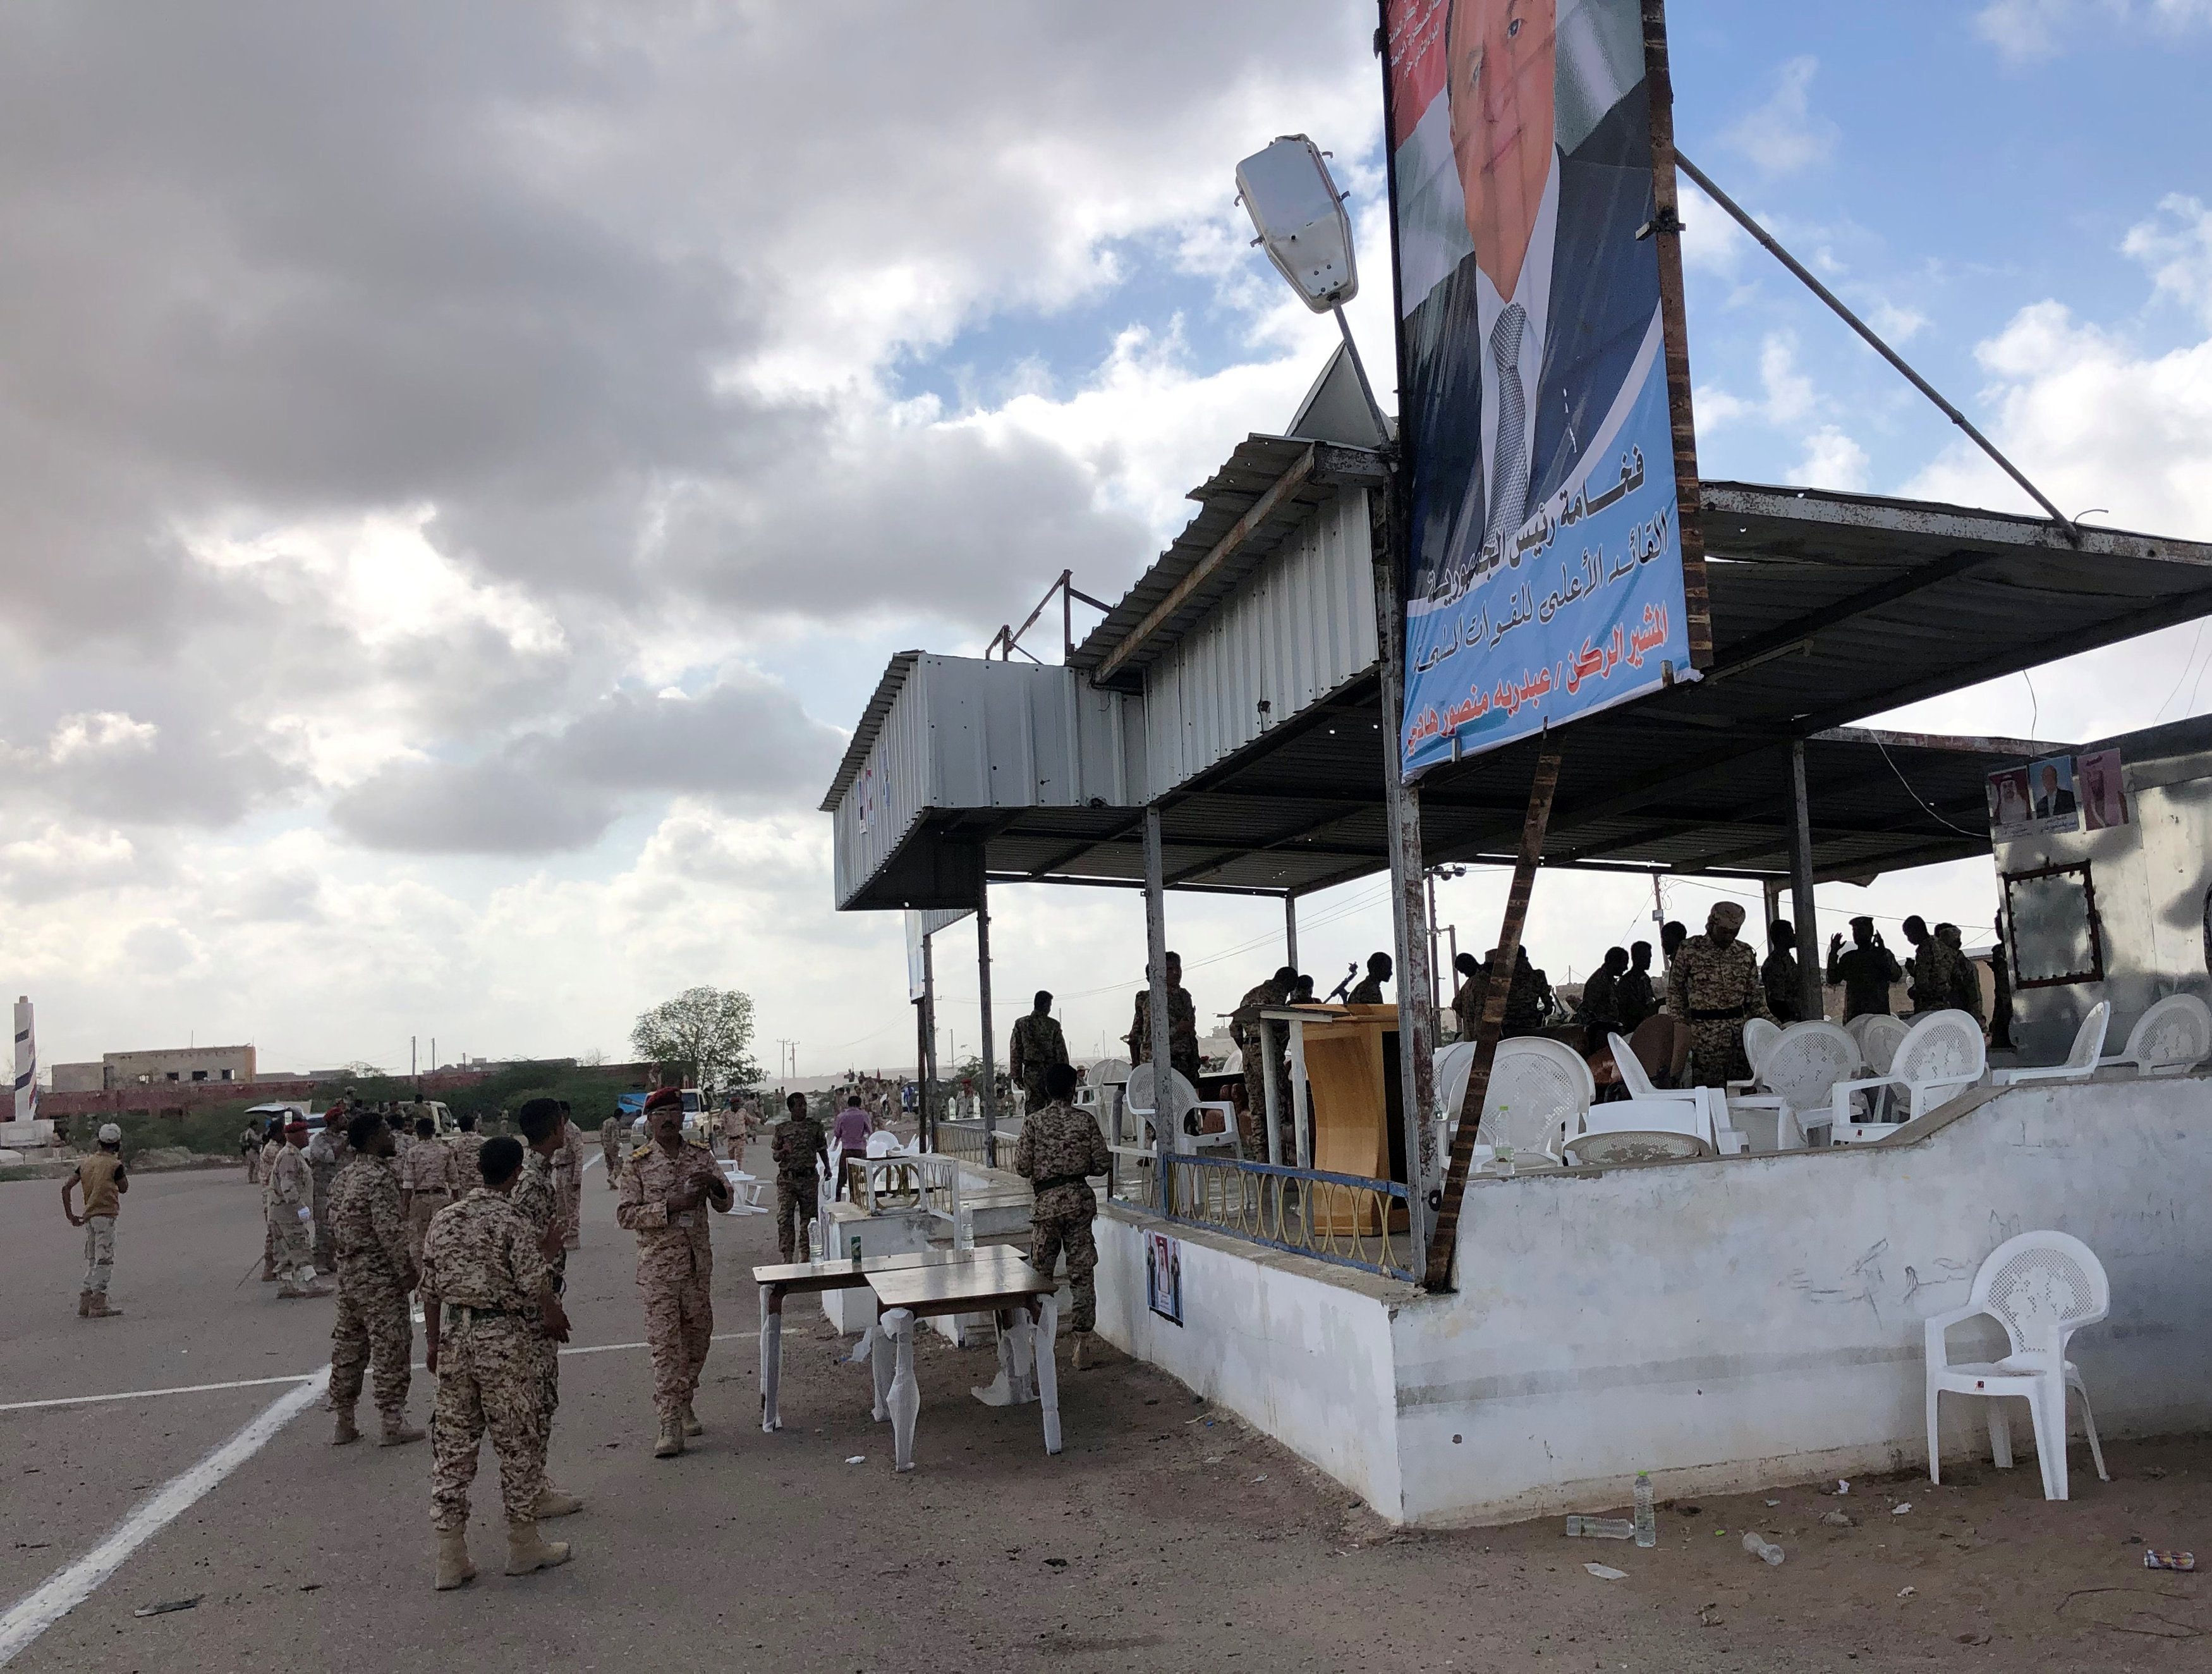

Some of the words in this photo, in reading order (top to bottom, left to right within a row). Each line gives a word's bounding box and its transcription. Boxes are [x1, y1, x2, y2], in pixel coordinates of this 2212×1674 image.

[1560, 446, 1644, 527] فخامة
[1428, 526, 1506, 606] الجمهورية
[1509, 503, 1555, 568] رئيس
[1608, 508, 1668, 583] القائد
[1466, 580, 1533, 652] للقوات
[1539, 542, 1604, 624] الأعلى
[1413, 613, 1463, 675] المسلحة
[1567, 622, 1624, 695] الركن
[1627, 600, 1668, 669] المشير
[1407, 703, 1438, 755] هادي
[1440, 683, 1489, 738] منصور
